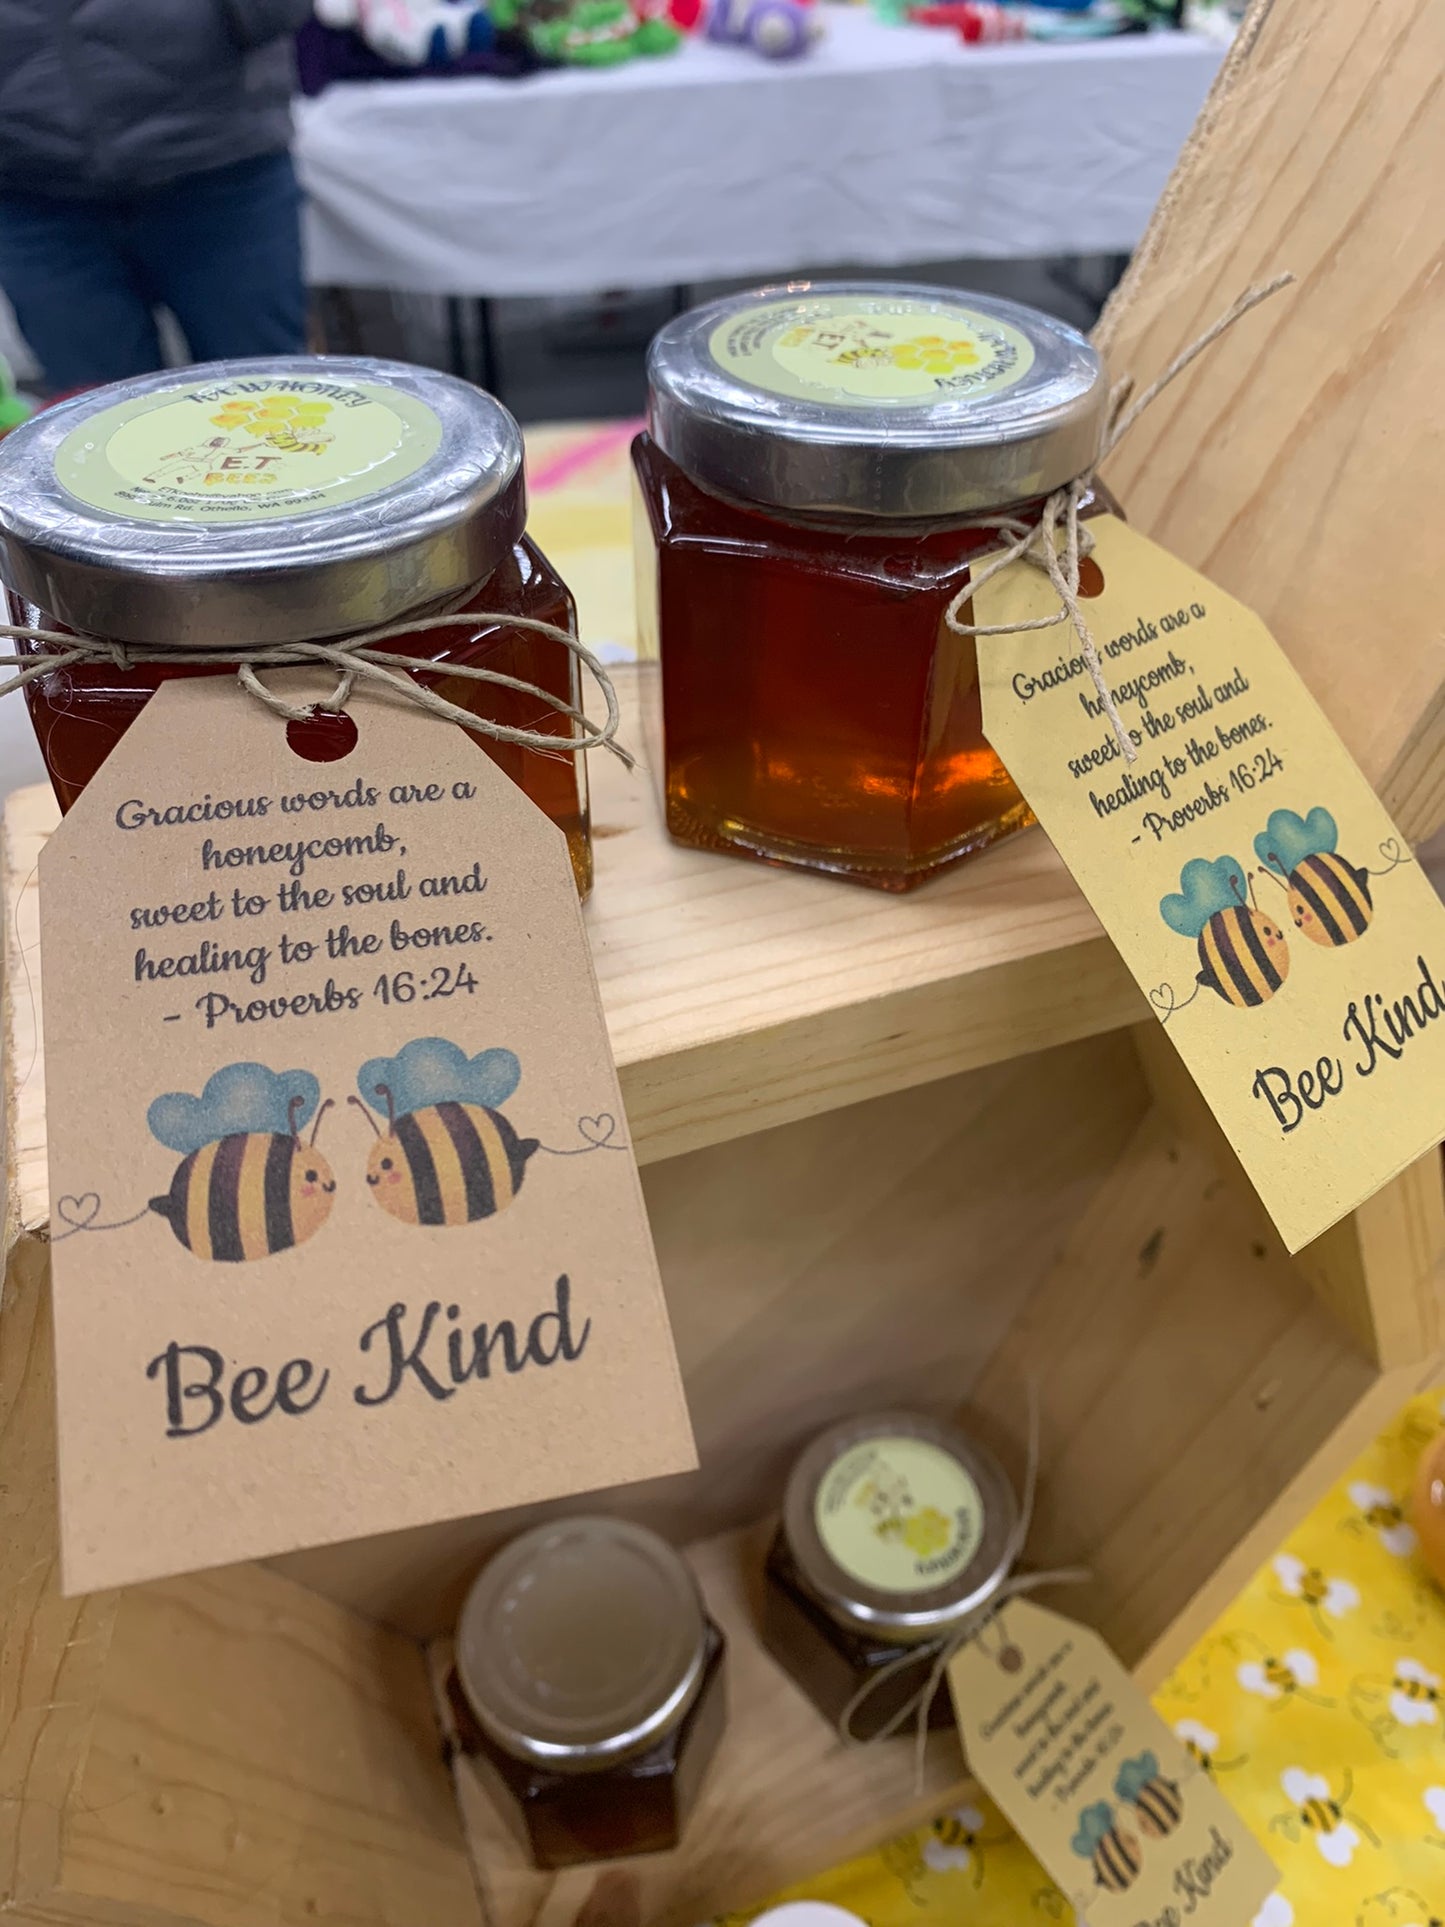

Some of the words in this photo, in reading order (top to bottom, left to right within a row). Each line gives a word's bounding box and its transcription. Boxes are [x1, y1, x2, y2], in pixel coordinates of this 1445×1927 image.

[258, 501, 281, 511] WA
[1104, 616, 1159, 659] words
[1160, 608, 1191, 634] are
[1190, 602, 1207, 620] a
[1067, 733, 1122, 780] sweet
[1140, 709, 1177, 740] the
[1175, 684, 1214, 725] soul
[1213, 666, 1250, 704] and
[1089, 768, 1172, 819] healing
[1162, 754, 1188, 780] to
[1185, 737, 1220, 768] the
[1214, 711, 1274, 751] bones.
[1142, 781, 1231, 842] Proverbs
[1229, 747, 1285, 794] 16:24
[115, 795, 274, 831] Gracious
[281, 777, 382, 814] words
[388, 783, 446, 805] are
[451, 781, 478, 800] a
[201, 822, 408, 877] honeycomb,
[129, 890, 225, 930] sweet
[230, 887, 272, 918] to
[276, 879, 336, 913] the
[341, 868, 413, 907] soul
[418, 861, 489, 898] and
[134, 940, 273, 985] healing
[277, 933, 320, 965] to
[324, 924, 384, 960] the
[389, 919, 495, 952] bones.
[194, 977, 364, 1030] Proverbs
[372, 962, 480, 1006] 16:24
[1252, 1056, 1344, 1134] Bee
[1343, 954, 1445, 1077] Kind
[146, 1340, 330, 1438] Bee
[353, 1273, 592, 1407] Kind
